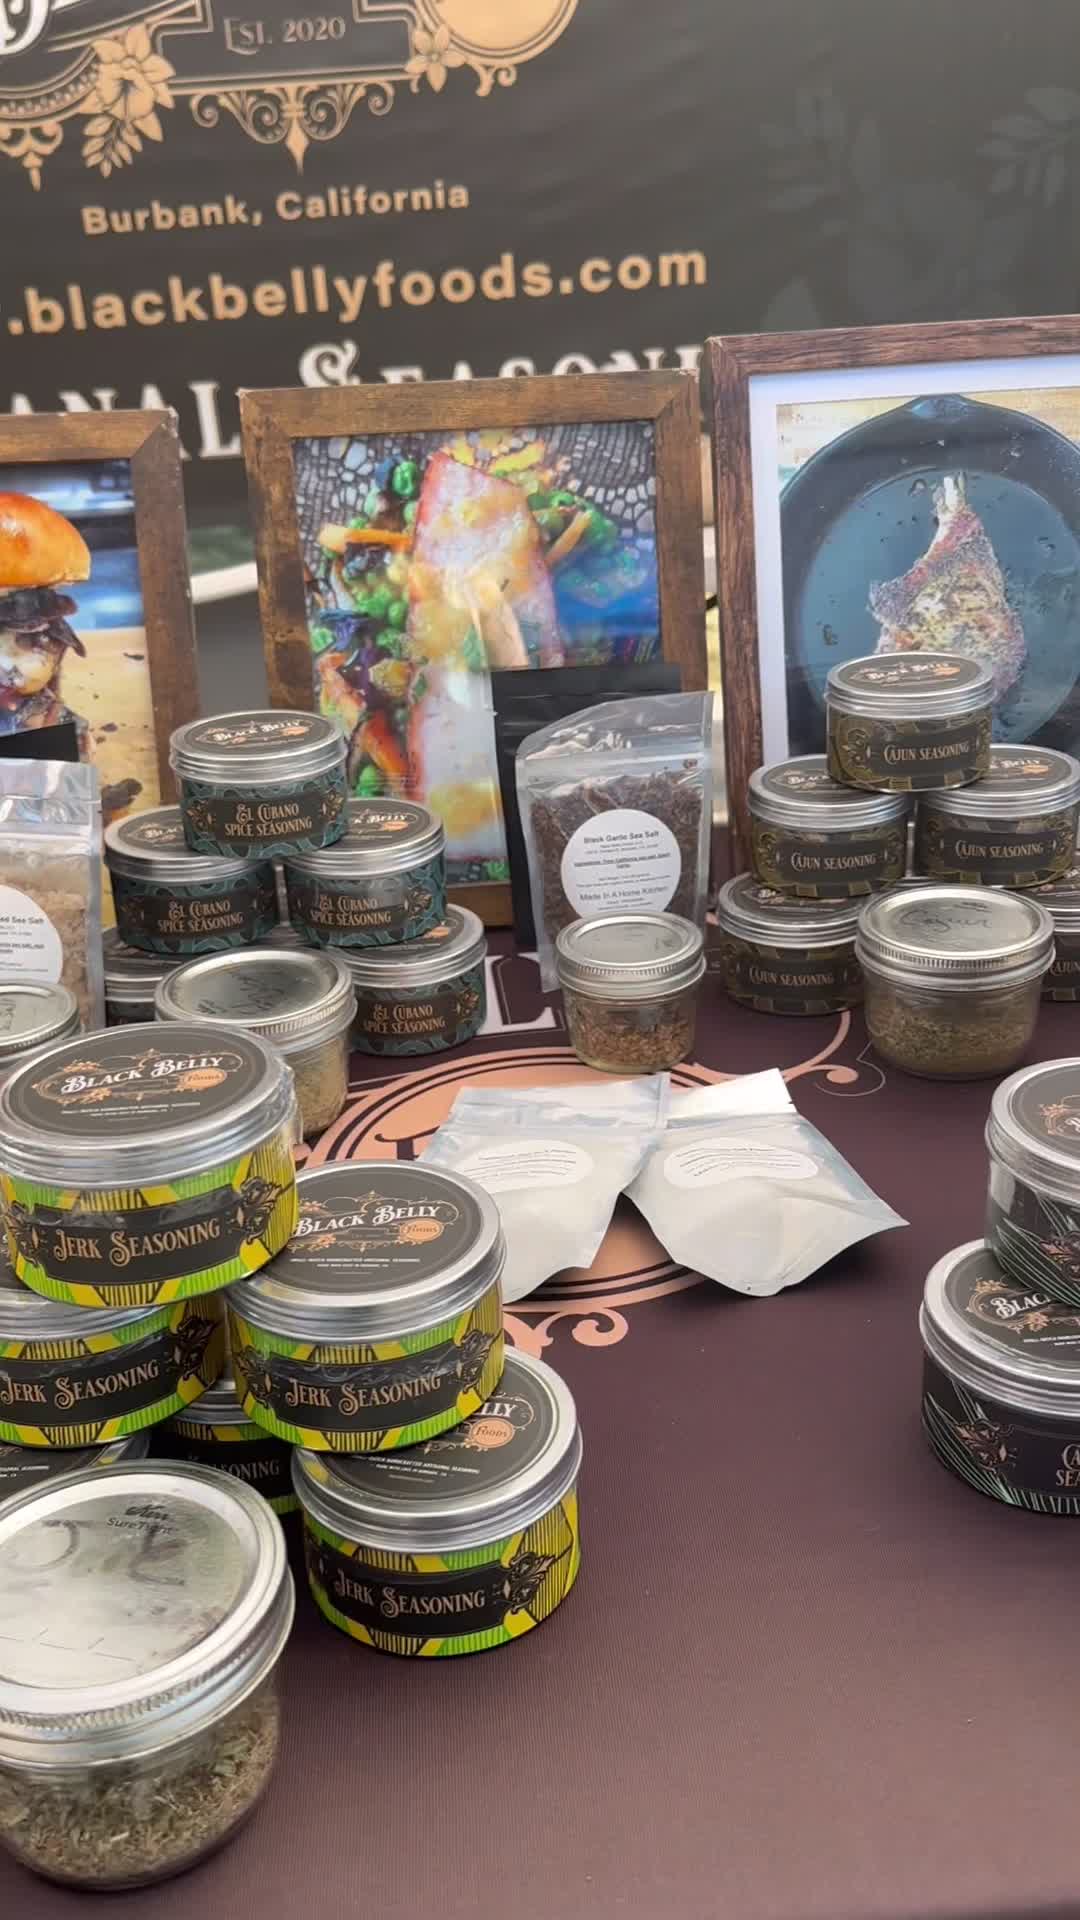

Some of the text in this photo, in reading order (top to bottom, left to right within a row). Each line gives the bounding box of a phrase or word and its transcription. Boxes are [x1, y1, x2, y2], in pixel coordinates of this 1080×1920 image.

[282, 16, 346, 44] 2020
[80, 180, 470, 235] Burbank, California
[7, 250, 708, 336] .blackbellyfoods.com
[884, 740, 970, 765] CAJUN SEASONING
[235, 803, 299, 824] EL CUBANO
[224, 816, 313, 837] SPICE SEASONING
[605, 833, 628, 842] Garlic
[629, 832, 643, 840] Sea
[644, 830, 659, 838] Salt
[955, 840, 1044, 859] CAJUN SEASONING
[791, 852, 876, 871] CAJUN SEASONING
[168, 899, 231, 921] EL CUBANO
[337, 895, 378, 913] CUBANO
[157, 911, 244, 933] SPICE SEASONING
[310, 909, 392, 926] SPICE SEASONING
[779, 974, 834, 986] SEASONING
[393, 1003, 434, 1022] CUBANO
[391, 1016, 446, 1034] SEASONING
[60, 1056, 223, 1094] BLACK BELLY
[295, 1204, 441, 1237] BLACK BELLY
[53, 1229, 103, 1261] JERK
[109, 1217, 221, 1267] SEASONING
[990, 1293, 1051, 1319] BLAC
[0, 1359, 160, 1410] JERK SEASONING
[285, 1375, 441, 1416] JERK SEASONING
[481, 1402, 518, 1417] LLY
[333, 1567, 485, 1618] JERK SEASONING
